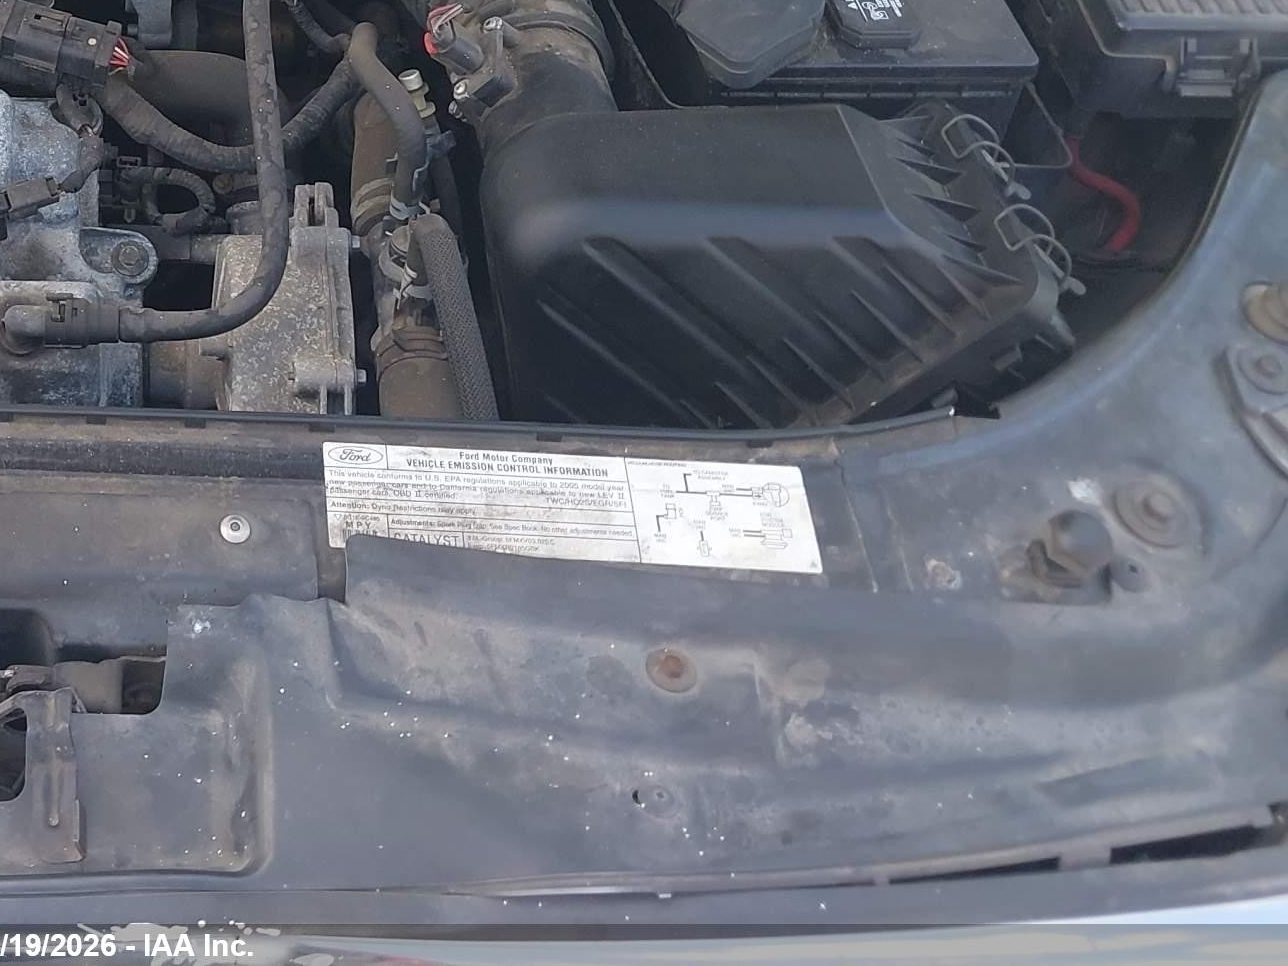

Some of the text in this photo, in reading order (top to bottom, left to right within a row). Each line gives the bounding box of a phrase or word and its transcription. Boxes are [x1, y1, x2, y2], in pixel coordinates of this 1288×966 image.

[339, 448, 371, 462] Ford
[459, 452, 552, 465] Ford Motor Company
[407, 459, 608, 477] VEHICLE EMISSION CONTROL INFORMATION
[463, 476, 506, 487] regulations
[509, 479, 548, 488] applicable
[331, 501, 370, 510] Attention:
